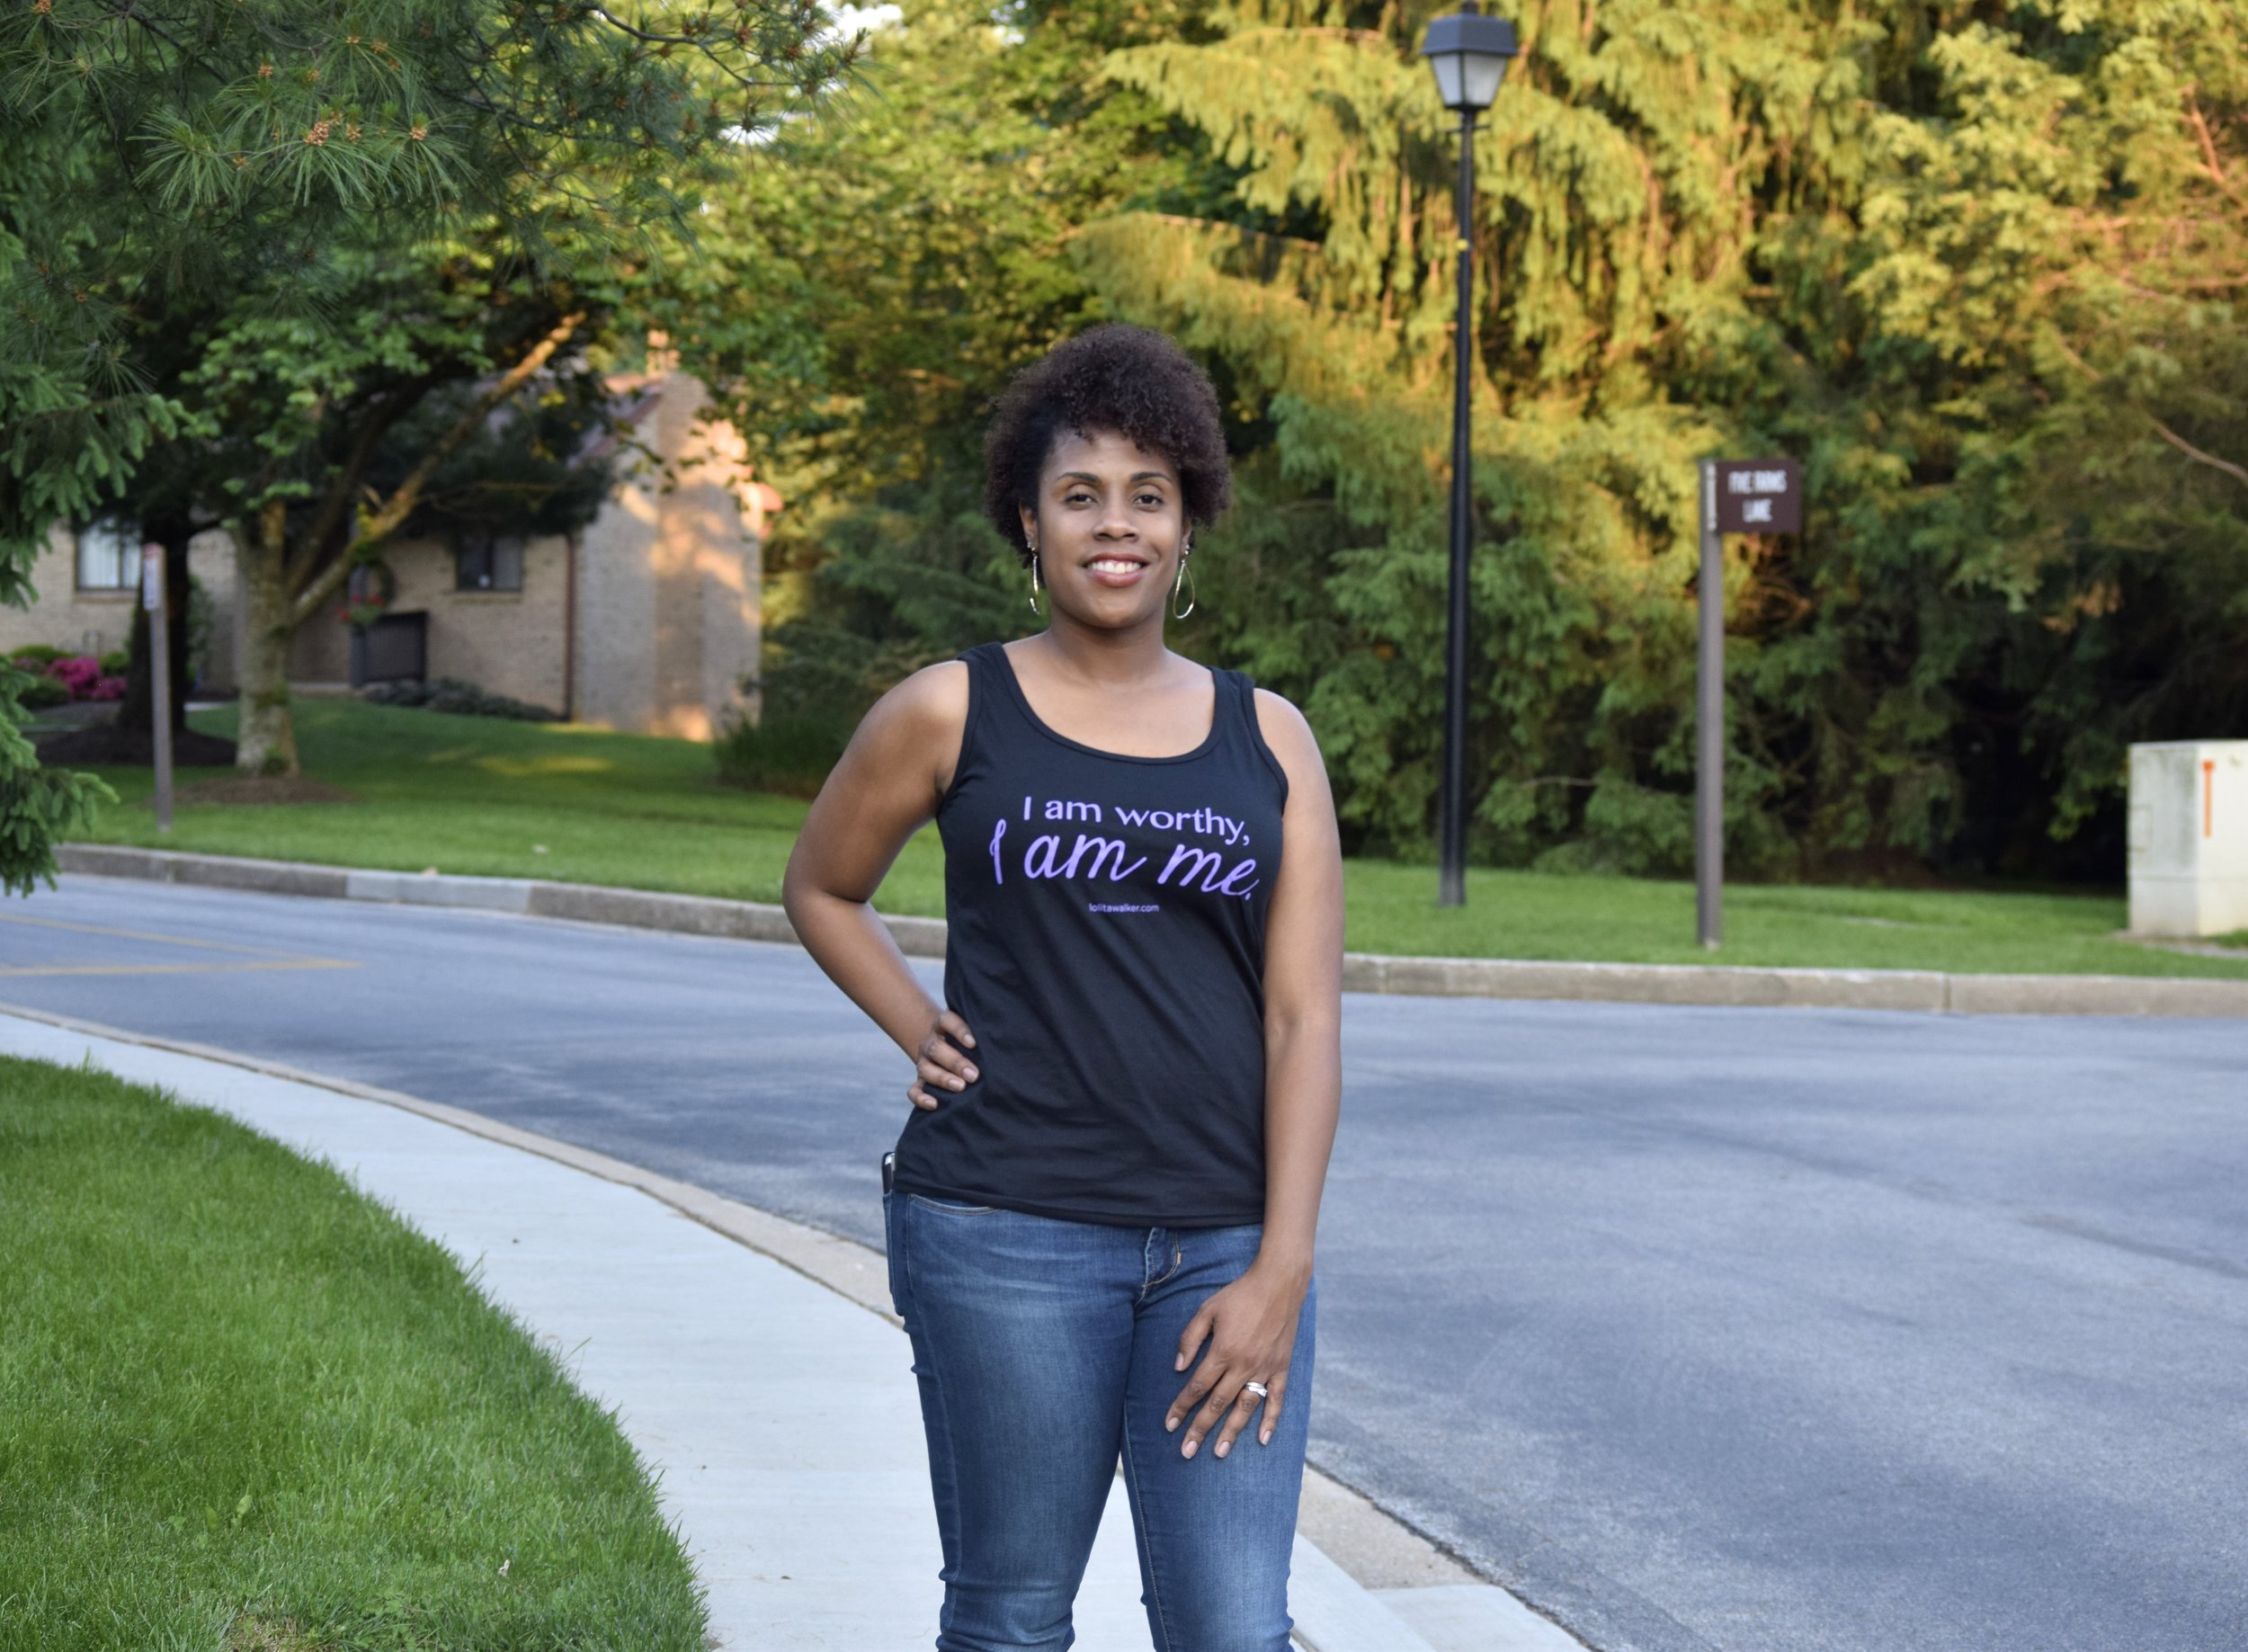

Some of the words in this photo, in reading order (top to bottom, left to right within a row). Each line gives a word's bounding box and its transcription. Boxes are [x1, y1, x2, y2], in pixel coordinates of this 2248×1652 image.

[1023, 796, 1032, 821] I
[1045, 799, 1102, 823] am
[1114, 807, 1251, 846] worthy,
[989, 818, 1007, 885] I
[1023, 834, 1148, 882] am
